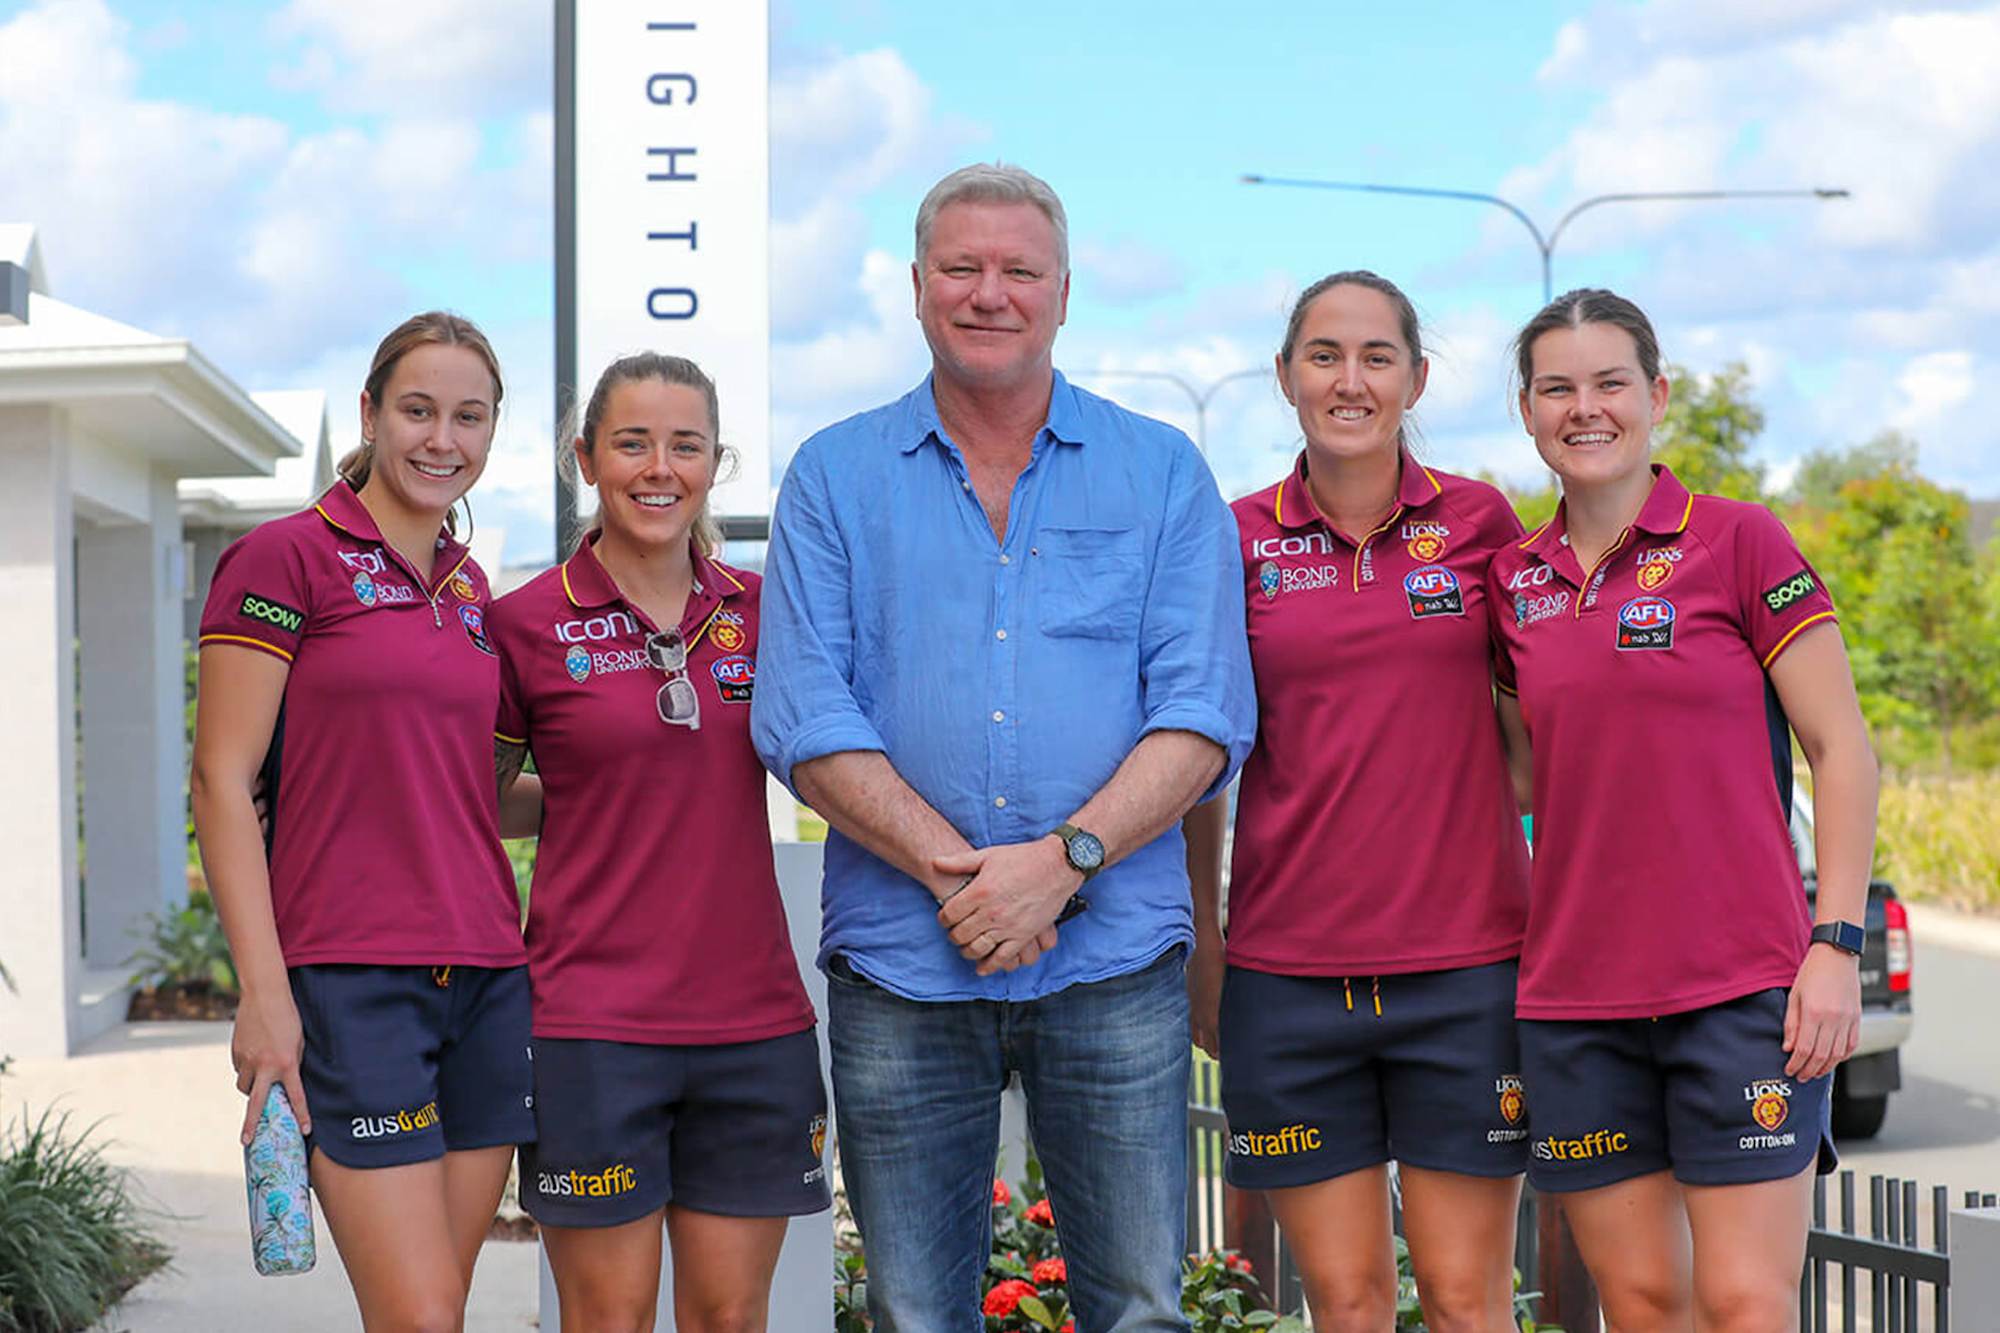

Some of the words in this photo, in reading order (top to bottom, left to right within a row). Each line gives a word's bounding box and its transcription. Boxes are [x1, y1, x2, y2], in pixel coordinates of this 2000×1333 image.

[1402, 525, 1449, 539] LIONS
[1637, 549, 1683, 565] LIONS
[1282, 565, 1338, 584] BOND
[1412, 573, 1454, 590] AFL
[1767, 573, 1815, 609] SOOW
[1528, 592, 1569, 615] BOND
[243, 597, 302, 631] SOOW
[1624, 605, 1670, 621] AFL
[1744, 1083, 1792, 1100] LIONS
[539, 1164, 637, 1196] austraffic
